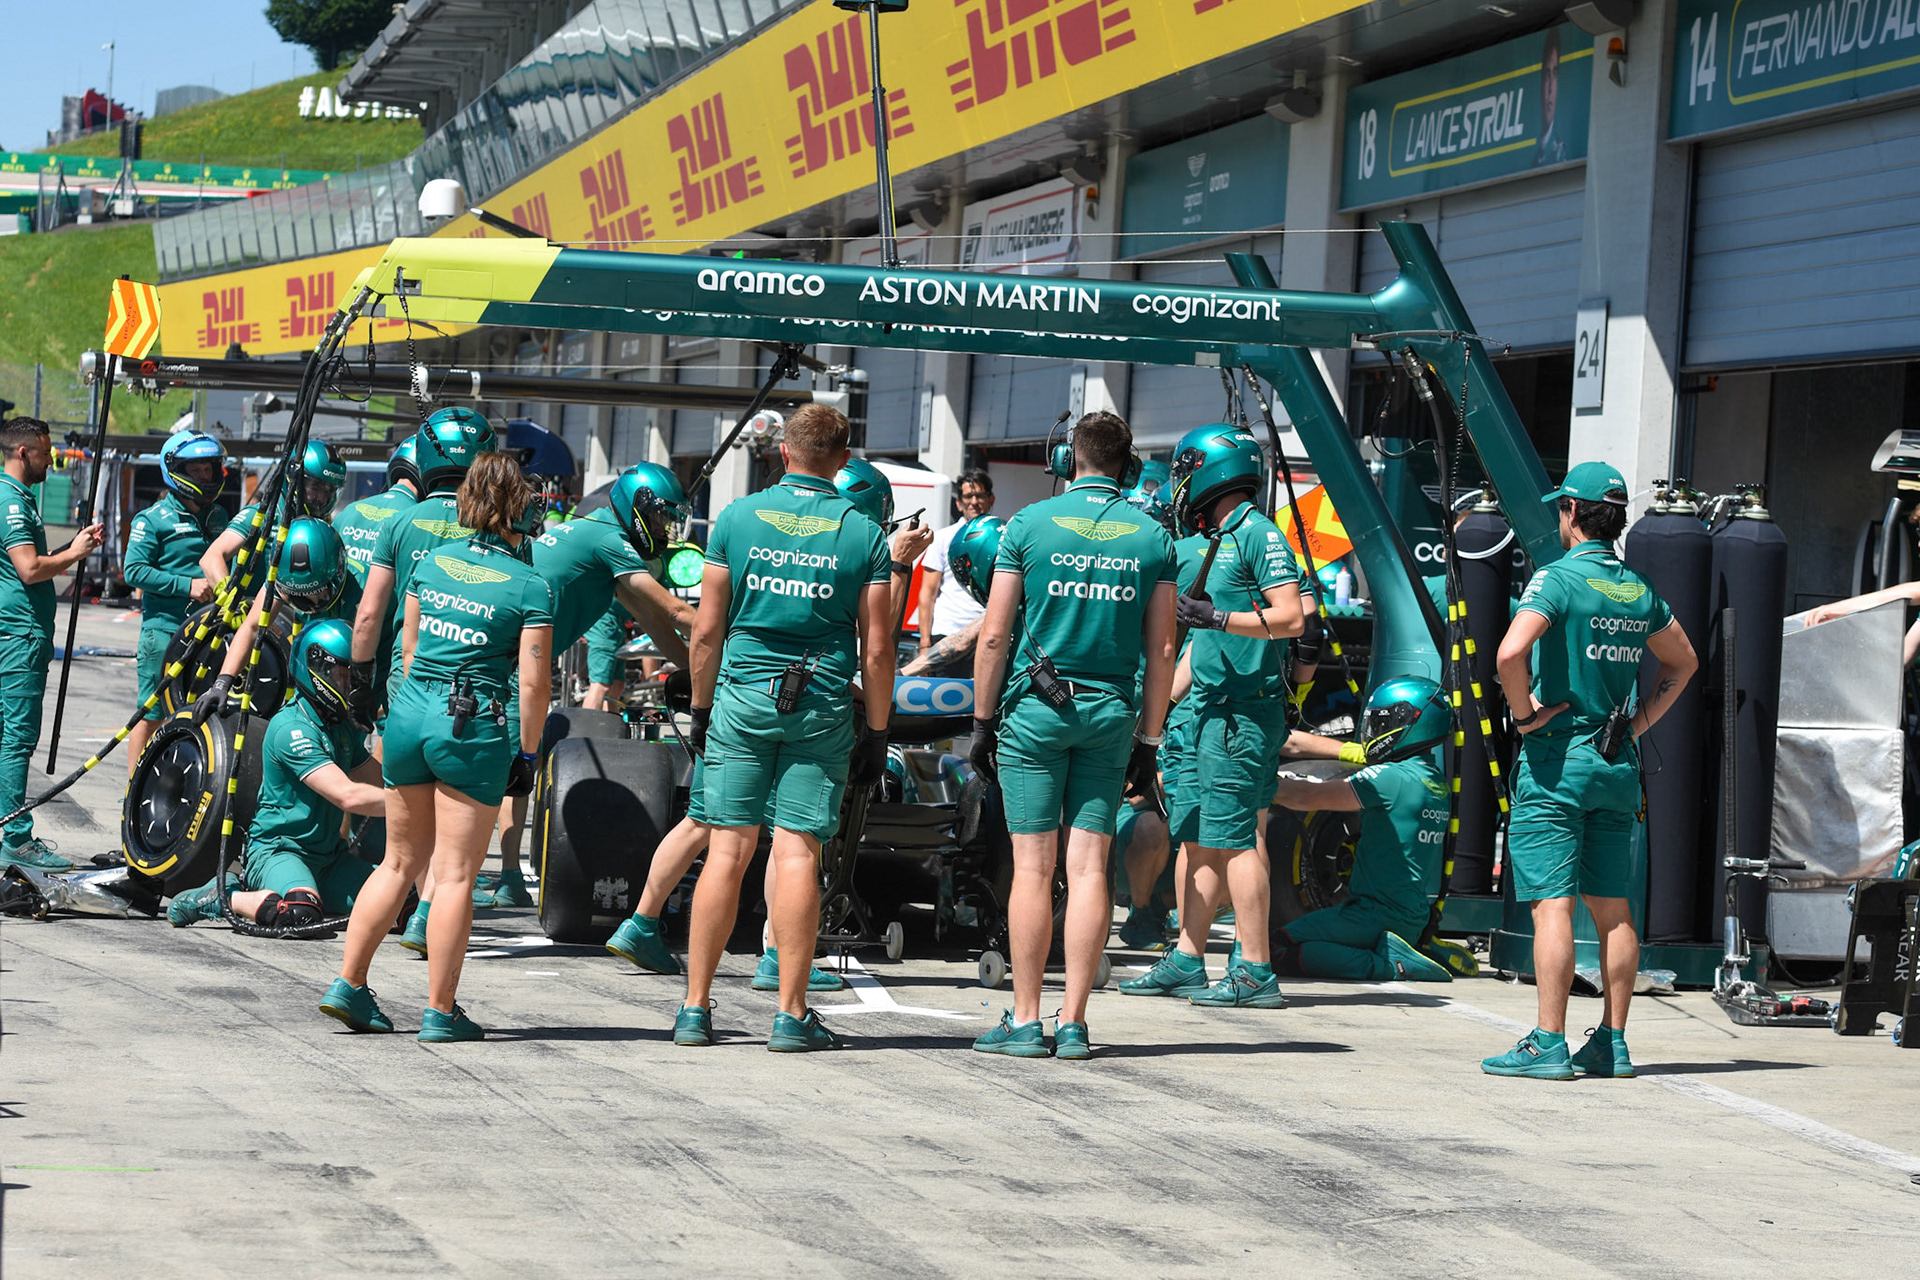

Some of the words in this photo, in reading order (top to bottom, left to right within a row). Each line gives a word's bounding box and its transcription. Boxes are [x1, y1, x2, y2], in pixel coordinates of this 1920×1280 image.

[1690, 11, 1717, 106] 14
[1738, 0, 1881, 79] FERNANDO
[784, 14, 903, 177] DHL
[1358, 108, 1377, 181] 18
[1405, 107, 1459, 163] LANCE
[1460, 88, 1524, 150] STROLL
[667, 92, 757, 226] DHL
[579, 149, 648, 251] DHL
[282, 272, 345, 338] DHL
[697, 269, 825, 297] aramco
[858, 276, 967, 306] ASTON
[976, 282, 1100, 314] MARTIN
[1132, 292, 1281, 323] cognizant
[200, 287, 256, 348] DHL
[1577, 329, 1600, 378] 24
[440, 424, 477, 434] aramco
[1086, 496, 1107, 504] BOSS
[343, 526, 380, 541] cogniz
[469, 545, 489, 555] BOSS
[749, 546, 839, 570] cognizant
[1050, 553, 1140, 572] cognizant
[286, 580, 319, 590] aramco
[421, 588, 496, 620] cognizant
[746, 573, 834, 599] aramco
[1048, 580, 1136, 601] aramco
[312, 677, 339, 705] cognizant
